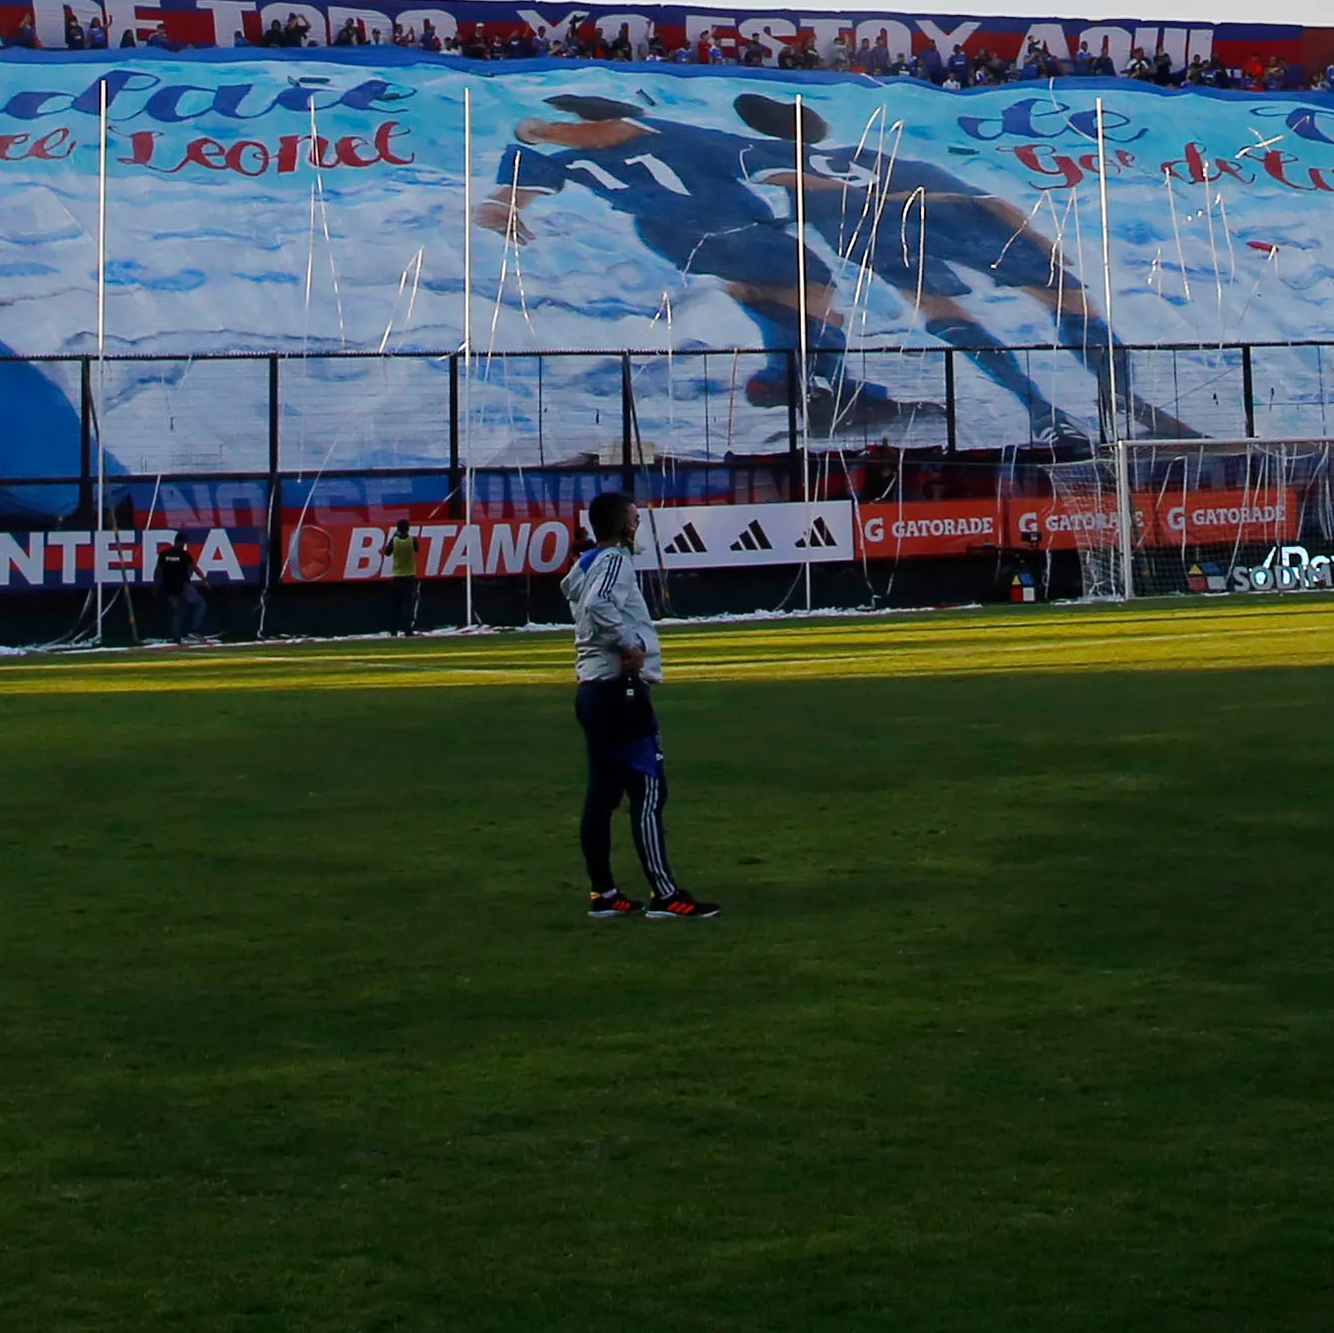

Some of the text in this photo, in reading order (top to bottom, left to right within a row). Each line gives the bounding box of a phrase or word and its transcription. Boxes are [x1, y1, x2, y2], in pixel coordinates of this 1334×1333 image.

[515, 8, 650, 60] YO
[685, 13, 981, 71] ESTOY
[1046, 509, 1145, 533] GATORAE
[1191, 504, 1287, 527] GATORADE
[864, 516, 994, 543] G GATORADE
[343, 520, 571, 580] BTANO
